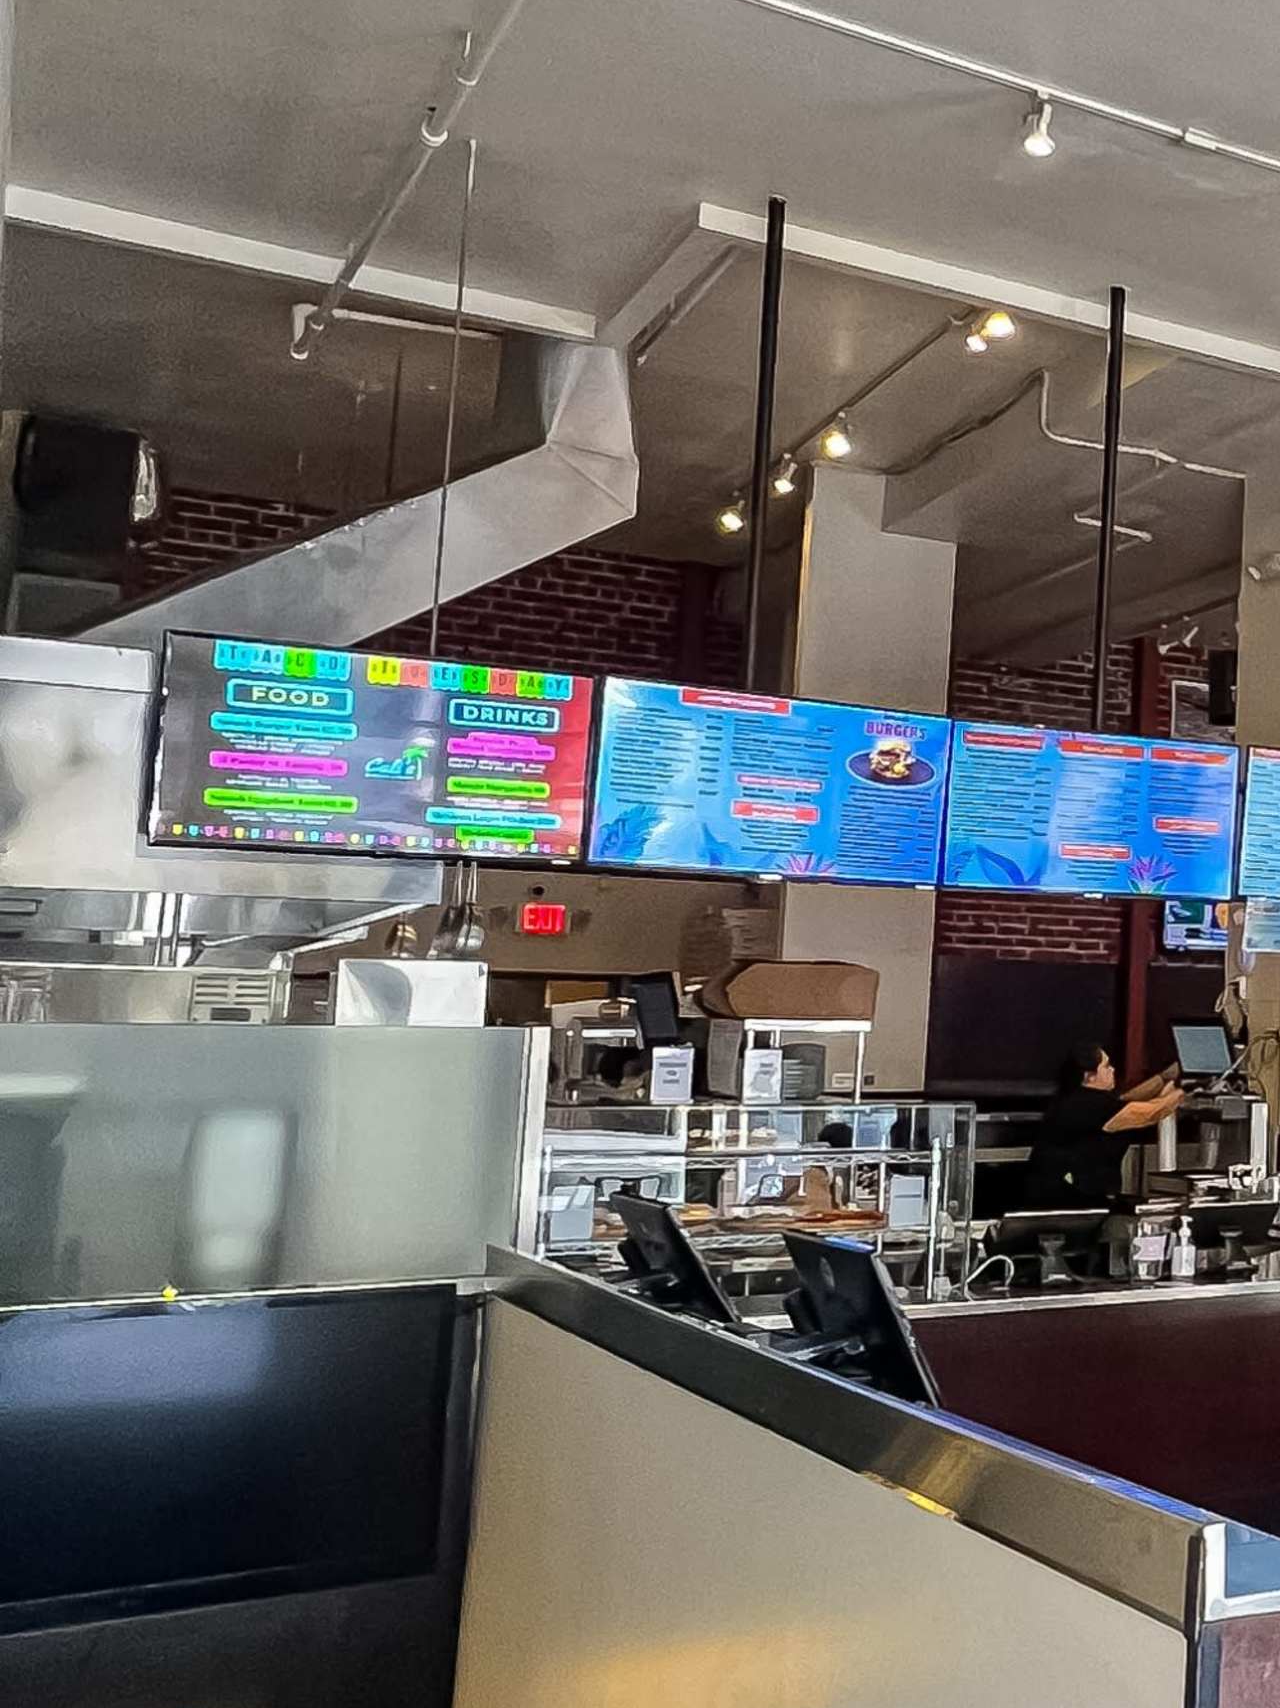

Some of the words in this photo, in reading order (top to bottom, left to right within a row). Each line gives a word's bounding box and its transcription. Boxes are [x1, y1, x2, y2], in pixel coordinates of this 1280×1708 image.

[228, 643, 340, 672] TACO
[371, 659, 568, 692] TUESDAY
[251, 686, 330, 707] FOOD
[462, 704, 550, 726] DRINKS
[865, 719, 927, 740] BURGERS
[523, 903, 566, 932] EXIT
